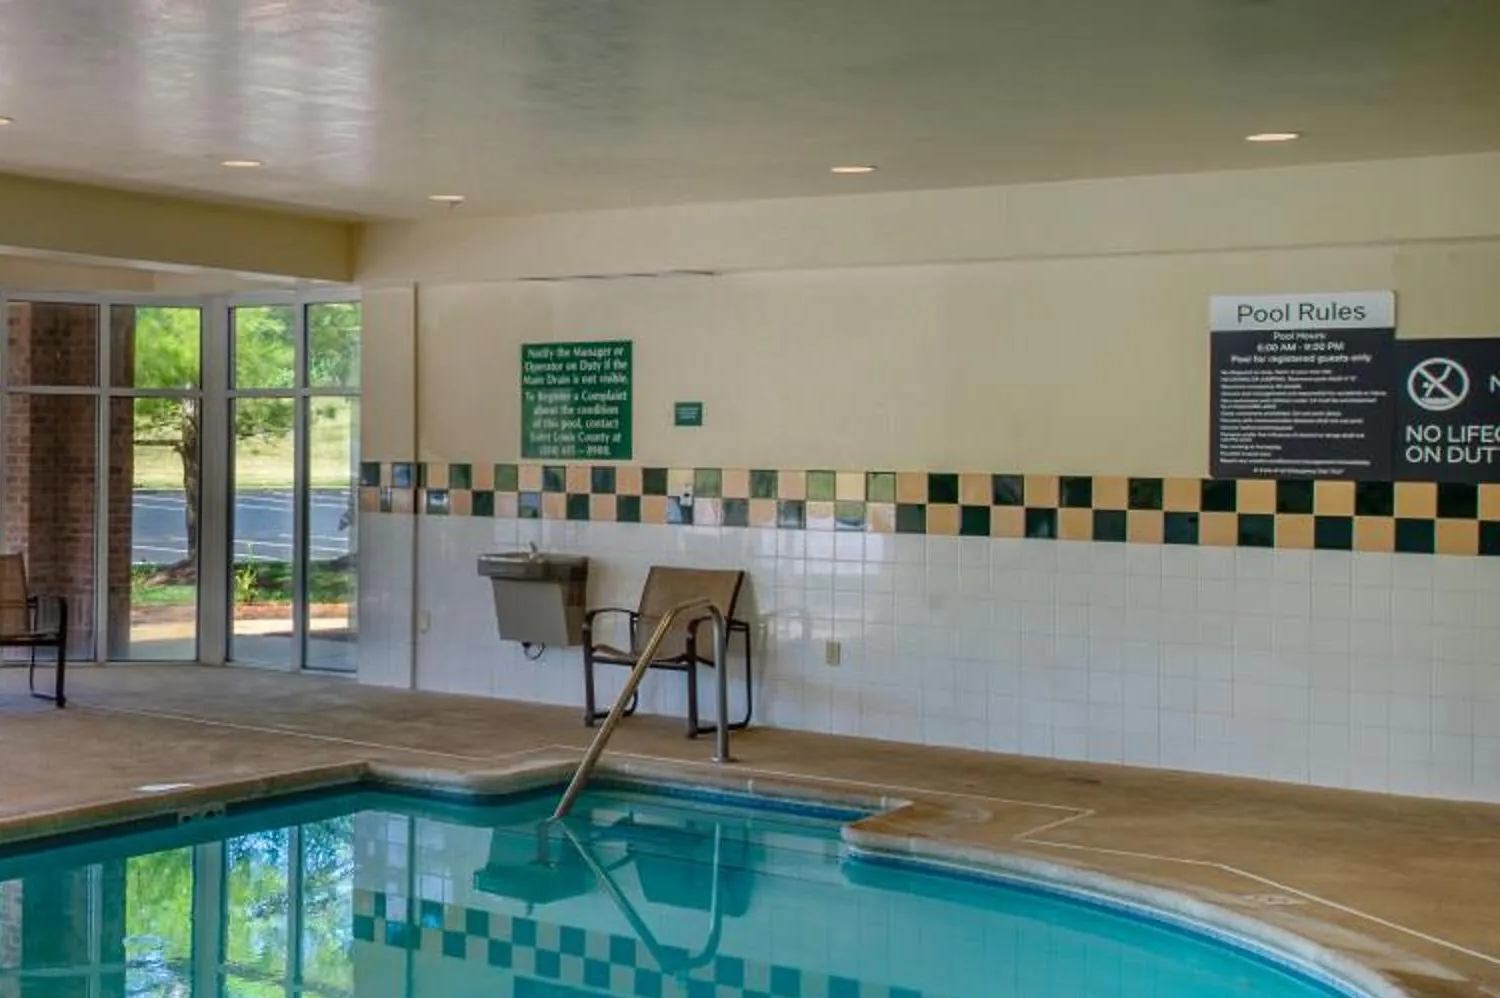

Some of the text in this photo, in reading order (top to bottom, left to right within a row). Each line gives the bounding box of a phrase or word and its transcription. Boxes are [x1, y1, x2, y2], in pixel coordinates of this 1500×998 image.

[1237, 302, 1366, 323] Pool Rules
[1405, 424, 1441, 443] NO
[1405, 445, 1500, 463] ON DUT
